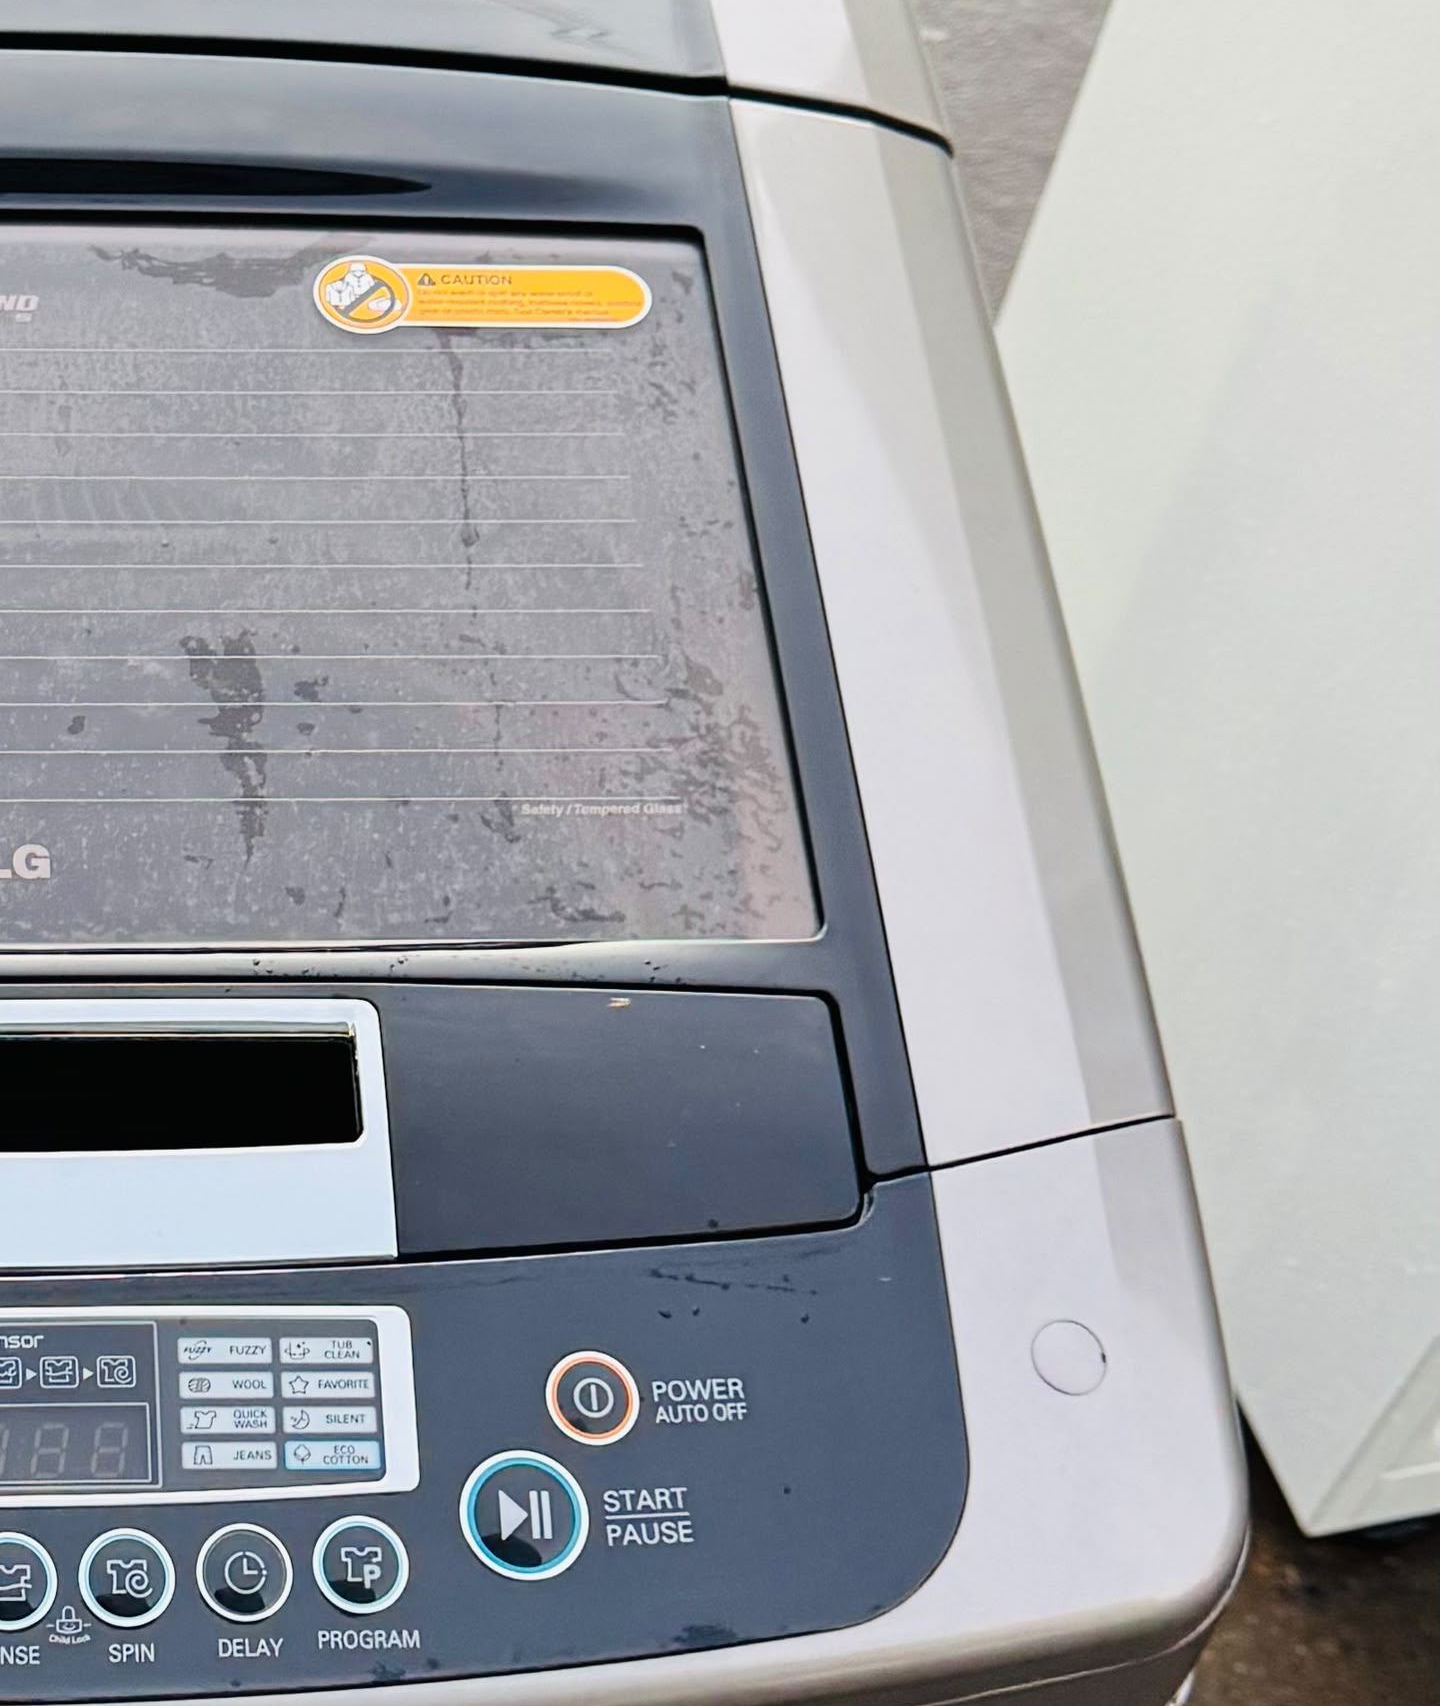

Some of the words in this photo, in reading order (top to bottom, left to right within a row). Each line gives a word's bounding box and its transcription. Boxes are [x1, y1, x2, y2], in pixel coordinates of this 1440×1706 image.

[440, 273, 513, 286] CAUTION
[574, 803, 640, 816] Tempered
[229, 1345, 267, 1355] FUZZY
[332, 1340, 353, 1349] TUB
[324, 1350, 360, 1359] CLEAN
[232, 1379, 267, 1390] WOOL
[318, 1379, 369, 1390] FAVORITE
[651, 1378, 745, 1402] POWER
[233, 1409, 268, 1419] QUICK
[326, 1413, 366, 1424] SILENT
[655, 1404, 709, 1424] AUTO
[712, 1403, 747, 1421] OFF
[234, 1420, 268, 1429] WASH
[233, 1450, 272, 1461] JEANS
[334, 1445, 356, 1455] ECO
[323, 1454, 369, 1465] COTTON
[603, 1487, 688, 1512] START
[606, 1521, 694, 1546] PAUSE
[317, 1630, 421, 1650] PROGRAM
[108, 1643, 155, 1664] SPIN
[218, 1638, 284, 1659] DELAY
